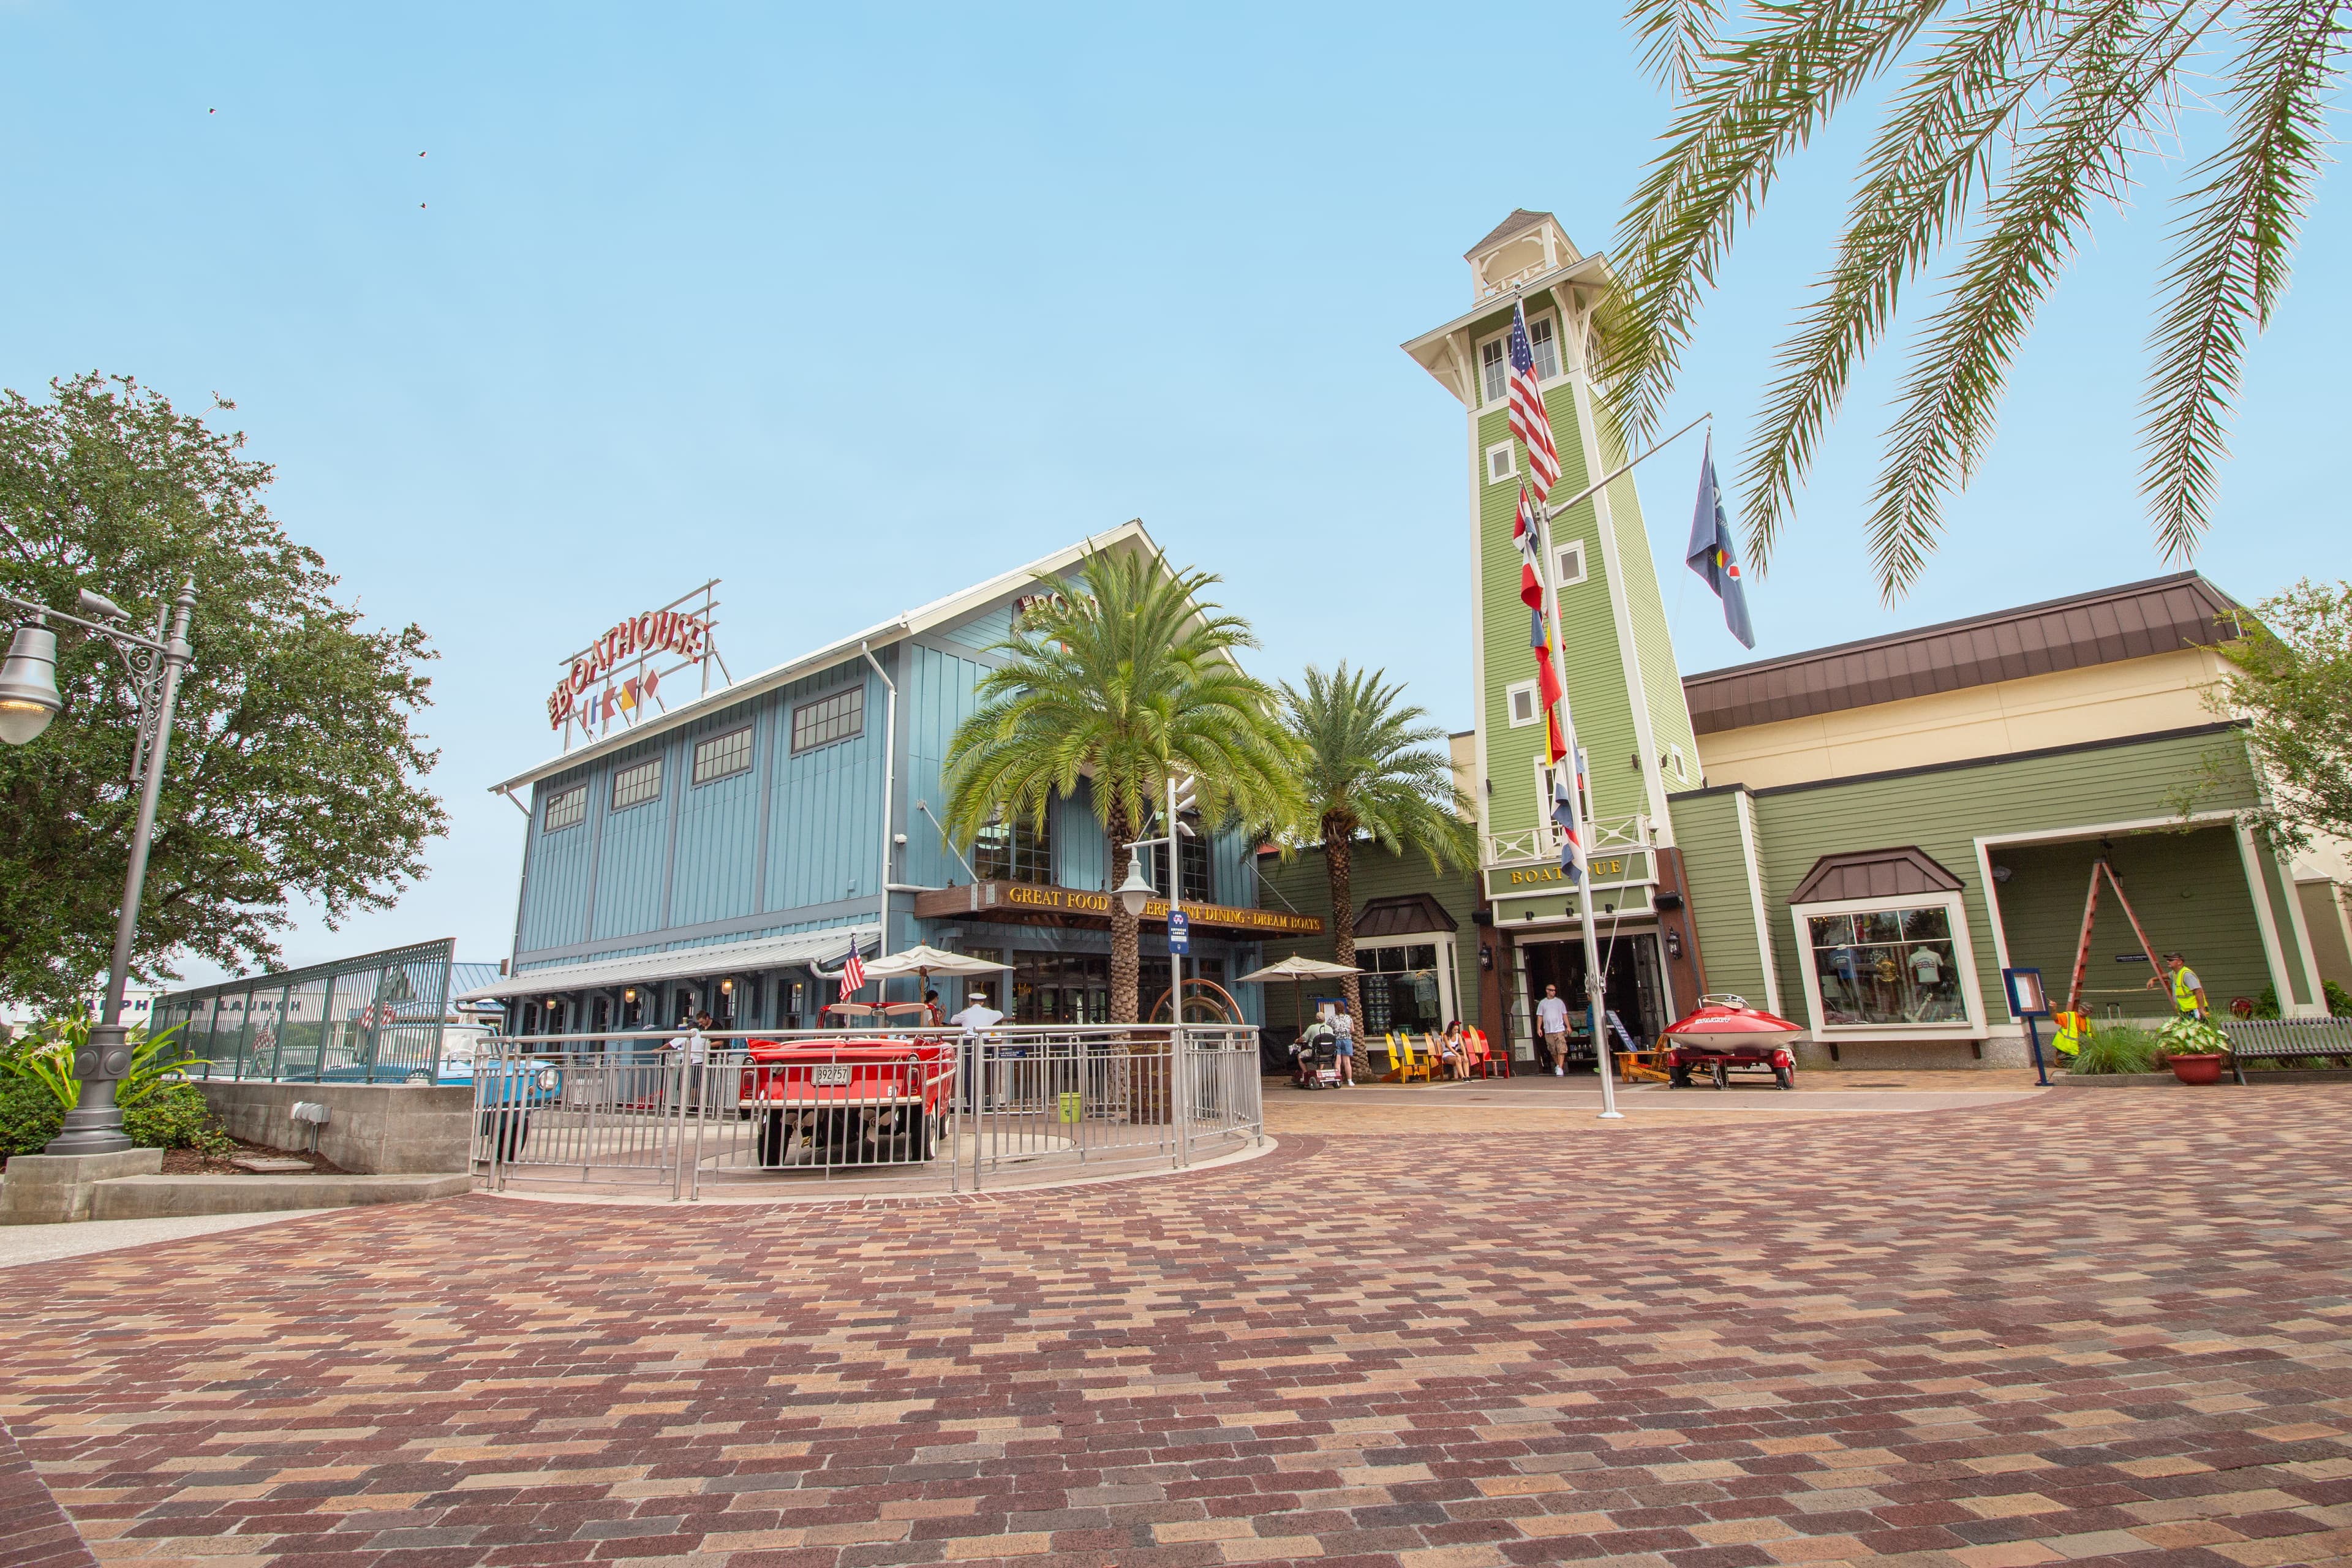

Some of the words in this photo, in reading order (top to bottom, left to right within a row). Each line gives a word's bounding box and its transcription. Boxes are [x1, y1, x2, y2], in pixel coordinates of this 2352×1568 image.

[556, 611, 709, 716] BOATHOUSE
[1510, 859, 1622, 884] BOATUE
[1009, 888, 1061, 906] GREAT
[1067, 893, 1108, 910] FOOD
[1205, 908, 1245, 924] DINING
[1254, 913, 1288, 927] DREAM
[1291, 916, 1320, 930] BOATS
